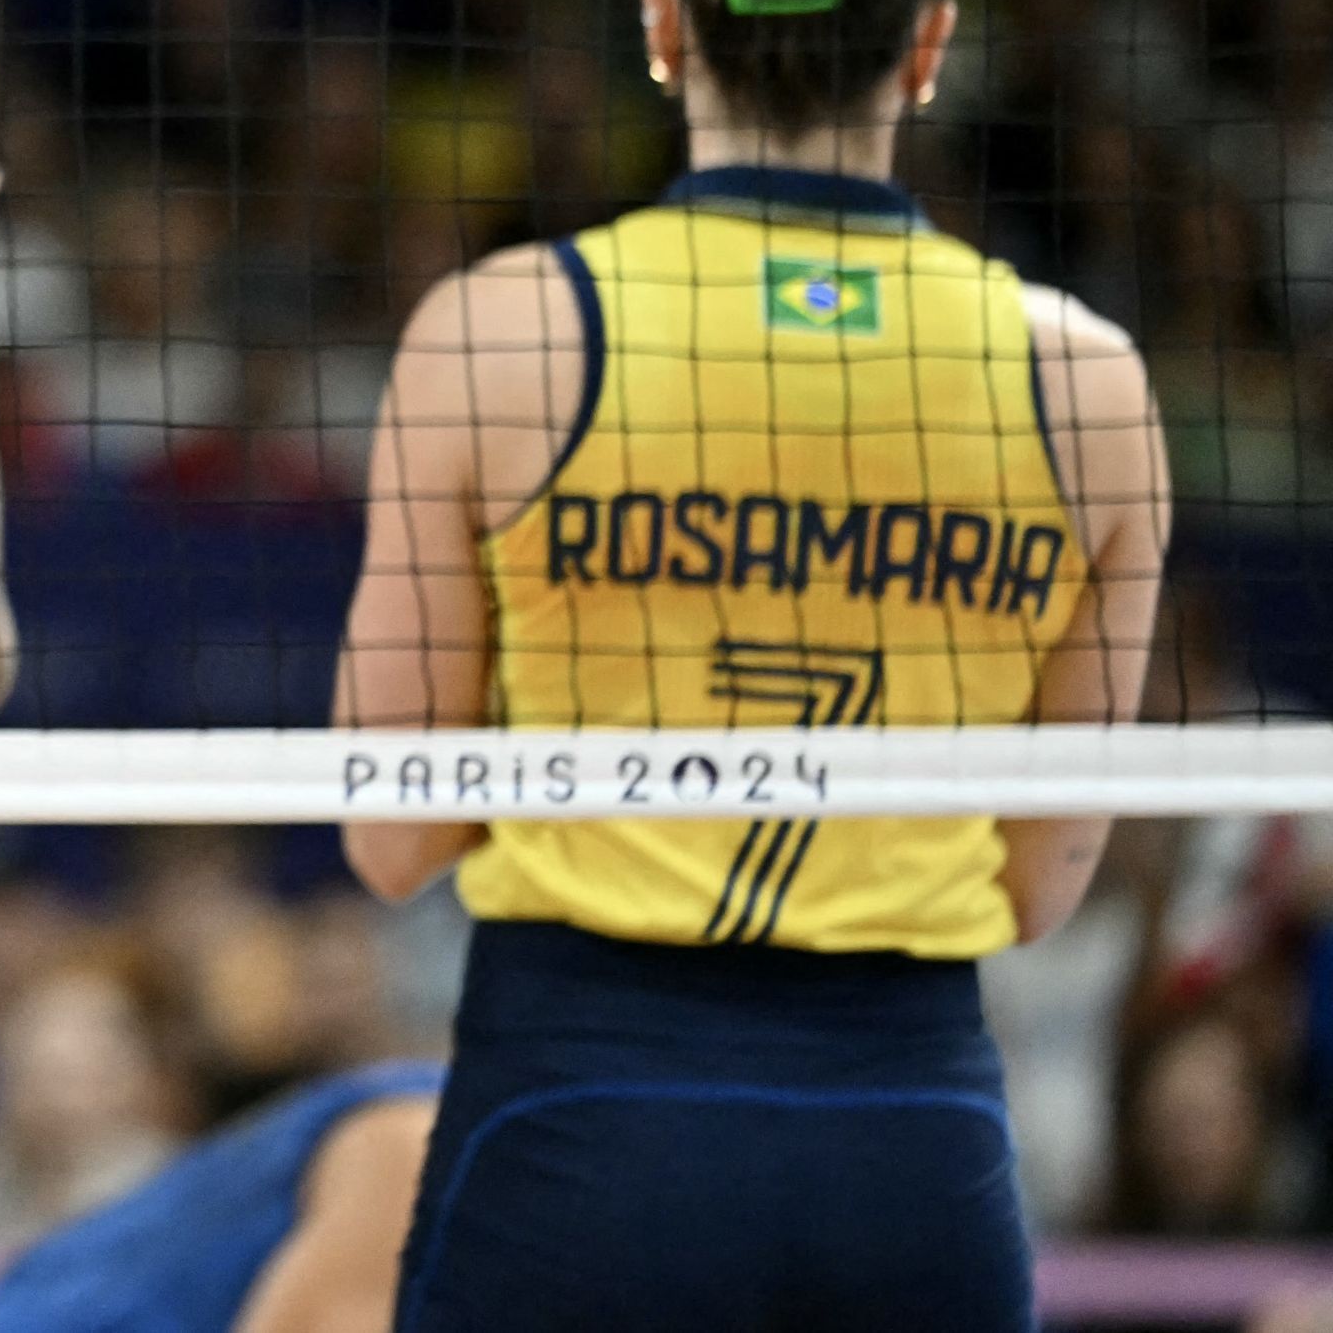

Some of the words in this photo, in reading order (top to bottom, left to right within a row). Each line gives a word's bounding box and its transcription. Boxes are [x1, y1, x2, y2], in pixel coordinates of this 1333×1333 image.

[544, 491, 1067, 621] ROSAMARIA
[617, 754, 829, 803] 2024
[705, 637, 883, 942] 7
